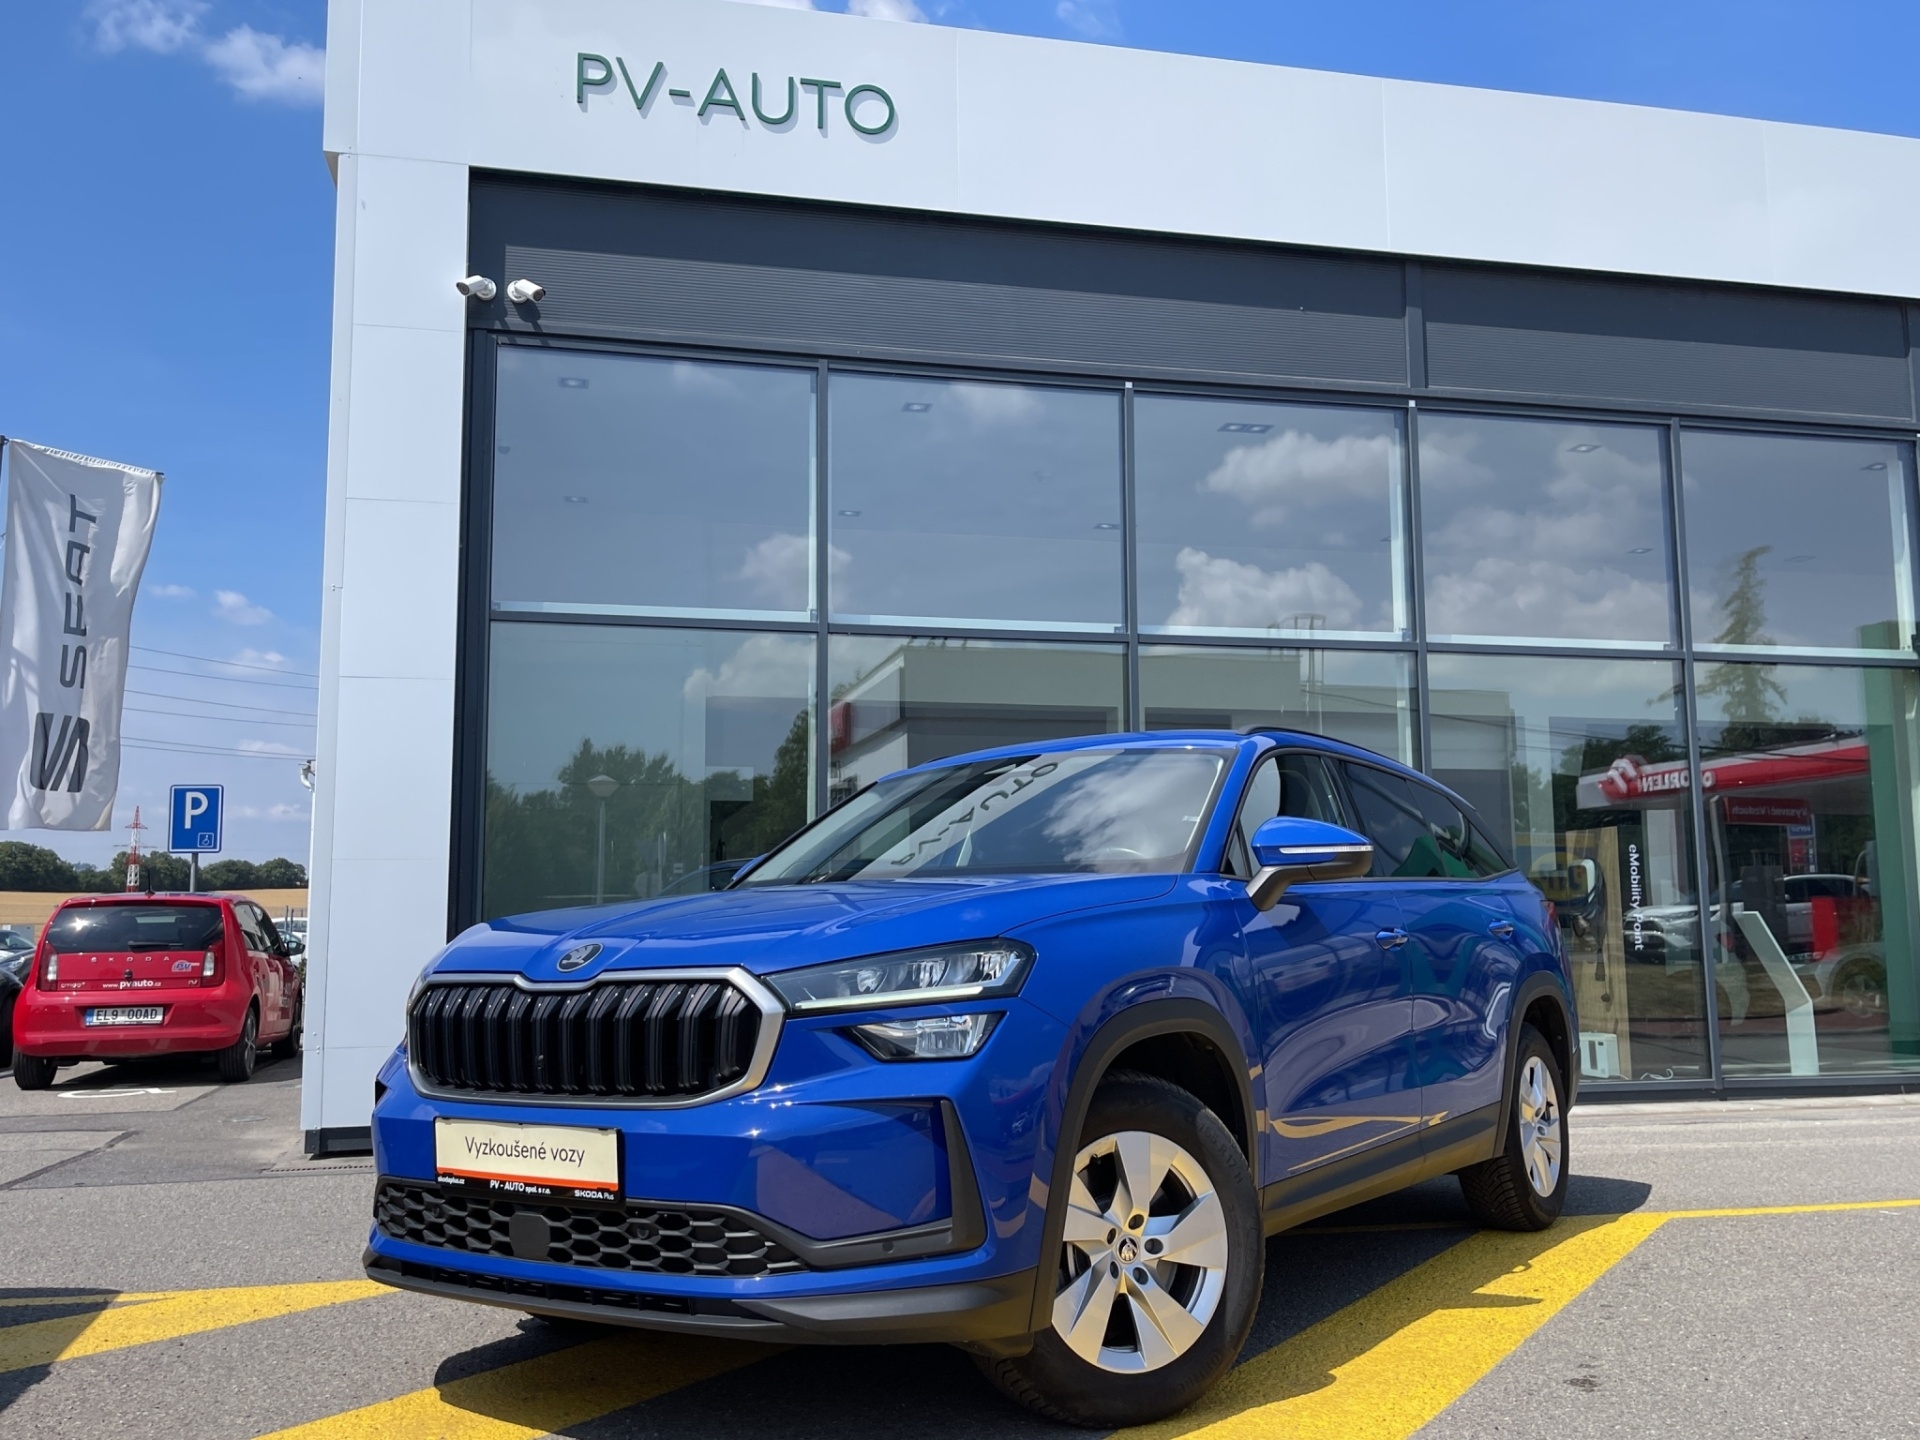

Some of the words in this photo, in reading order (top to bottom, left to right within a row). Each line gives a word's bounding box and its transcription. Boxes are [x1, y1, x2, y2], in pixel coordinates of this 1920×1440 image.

[577, 52, 895, 135] PV-AUTO
[184, 791, 209, 829] P
[1629, 843, 1642, 909] eMobility
[1633, 914, 1645, 951] Point
[96, 1008, 119, 1021] EL9
[464, 1135, 547, 1161] Vyzkoušené
[550, 1147, 586, 1168] vozy
[504, 1181, 525, 1192] AUTO
